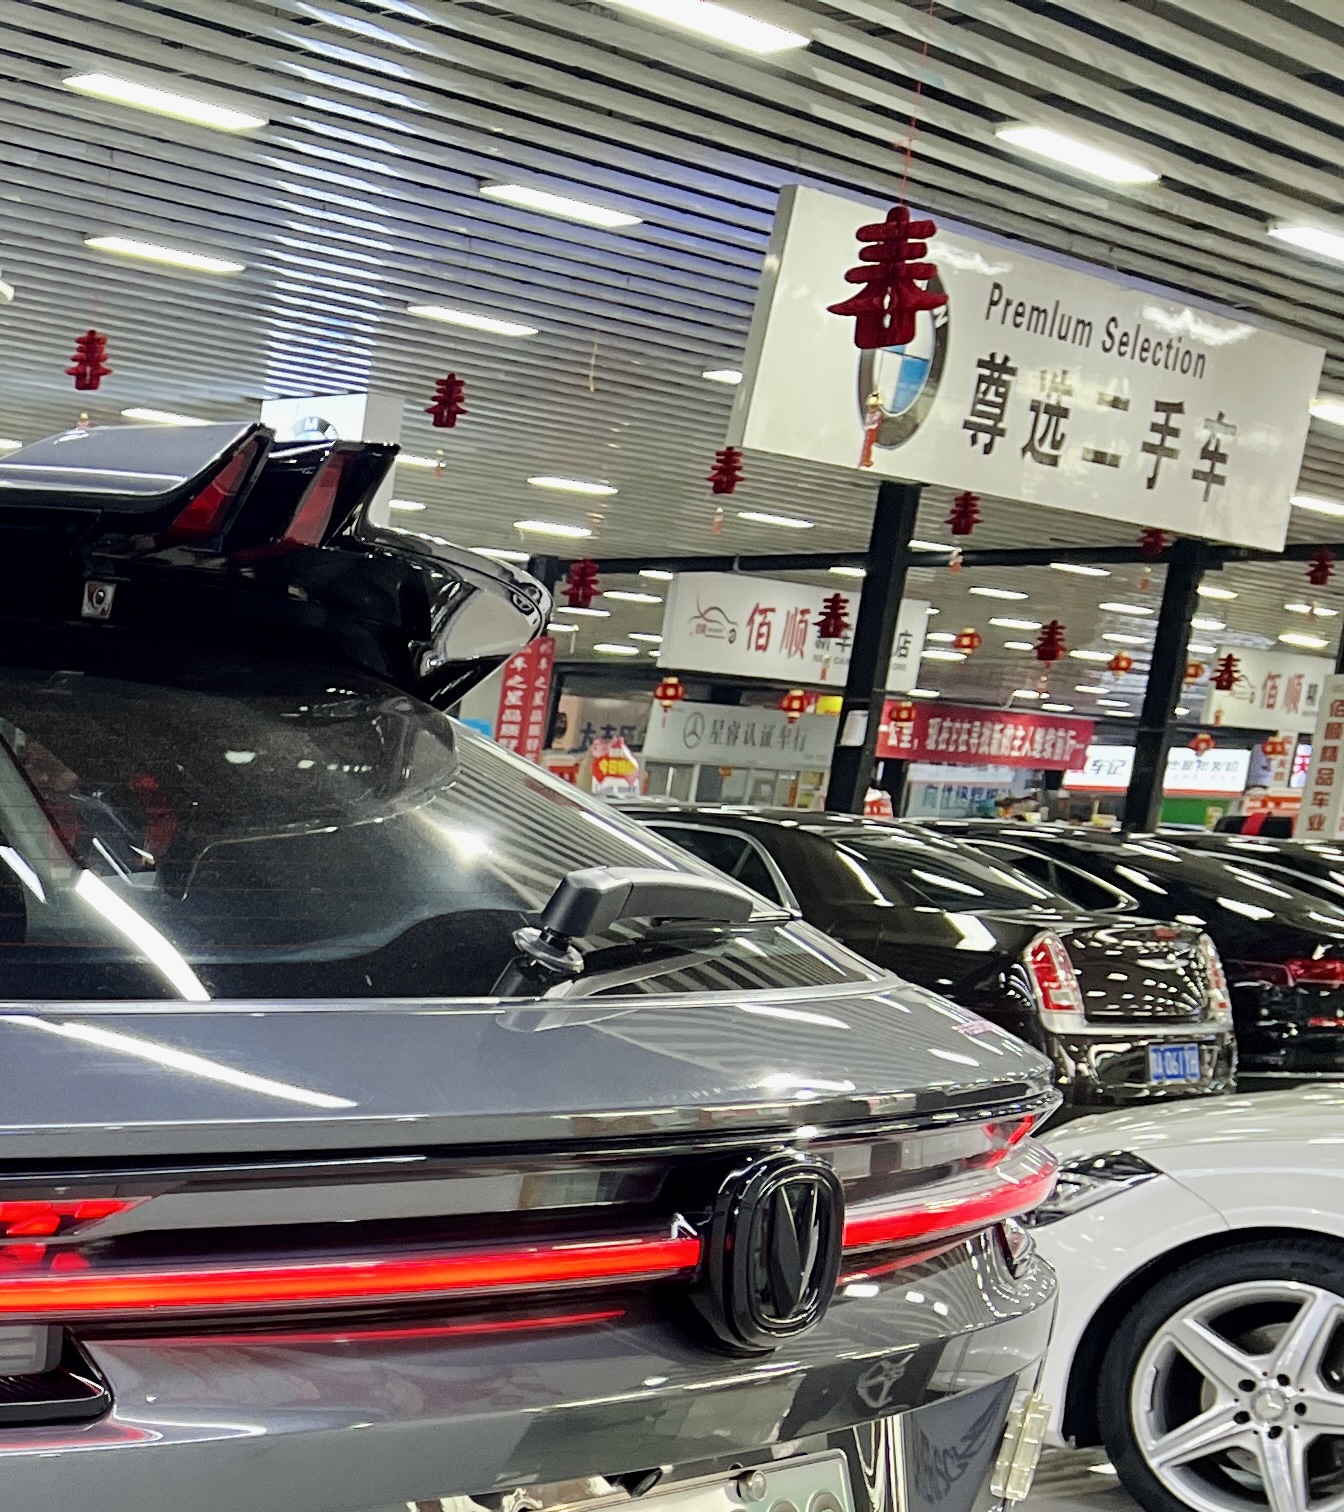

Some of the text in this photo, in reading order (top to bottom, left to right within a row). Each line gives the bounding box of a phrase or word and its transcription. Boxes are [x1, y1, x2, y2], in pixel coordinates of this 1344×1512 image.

[1101, 316, 1206, 380] Selection
[962, 351, 1238, 504] 尊选二手车
